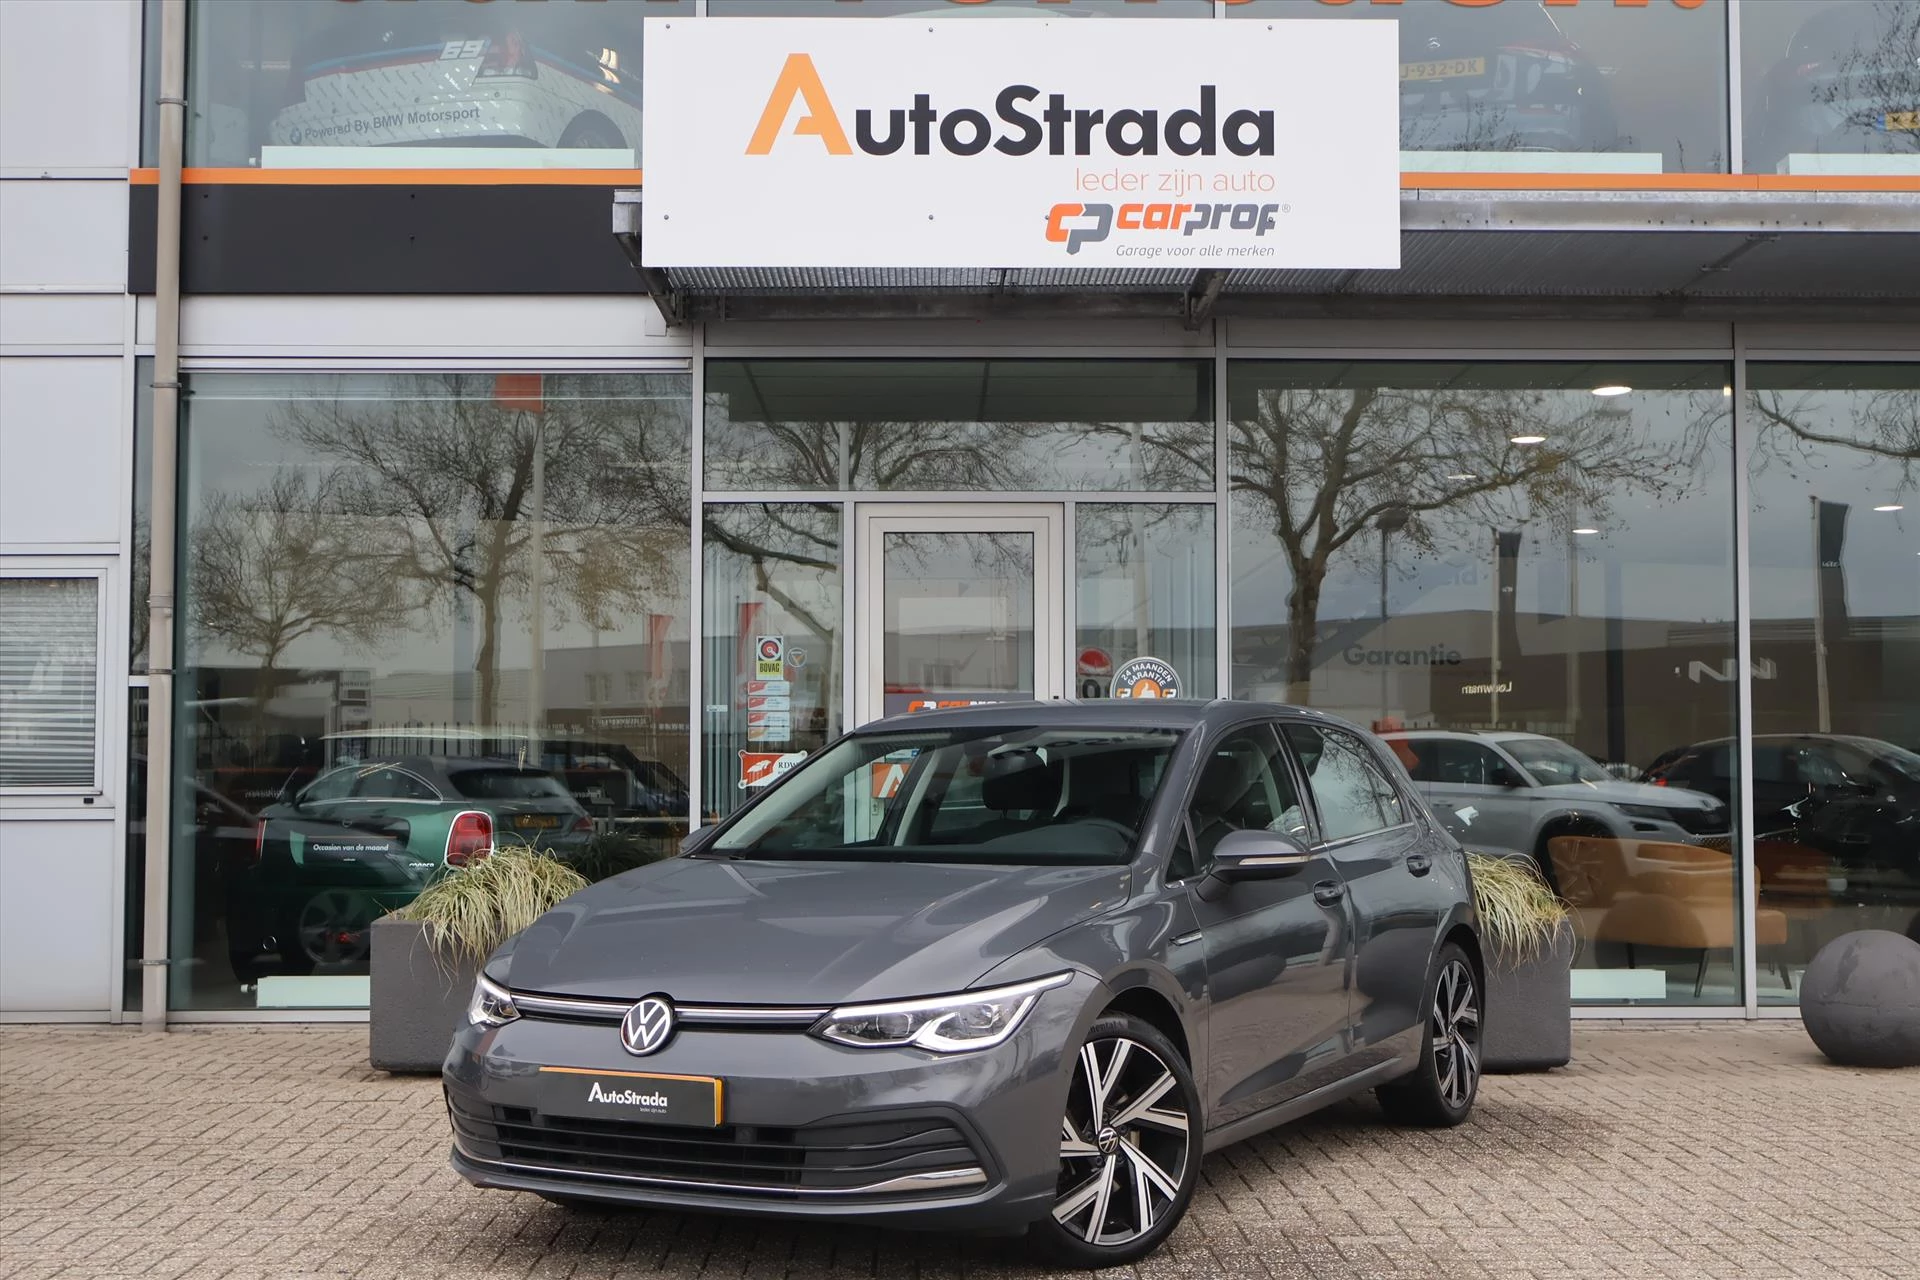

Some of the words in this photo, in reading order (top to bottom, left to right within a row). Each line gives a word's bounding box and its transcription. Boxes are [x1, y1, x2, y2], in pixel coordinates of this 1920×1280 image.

[439, 39, 484, 60] 69
[744, 53, 1275, 157] AutoStrada
[305, 123, 351, 139] Powered
[354, 119, 369, 135] By
[372, 113, 405, 129] BMW
[407, 106, 481, 125] Motorsport
[1075, 168, 1149, 192] Ieder
[1158, 169, 1208, 197] zijn
[1213, 170, 1275, 192] auto
[1116, 244, 1162, 258] Garage
[1166, 246, 1197, 257] voor
[1199, 244, 1223, 257] alle
[1225, 244, 1275, 257] merken
[1343, 643, 1462, 666] Garantie
[759, 662, 780, 674] BOVAG
[1121, 670, 1133, 681] 24
[1131, 662, 1173, 683] MAANDEN
[1127, 670, 1167, 687] GARANTIE
[313, 843, 342, 852] Occasion
[342, 844, 355, 852] van
[355, 843, 364, 852] de
[365, 843, 389, 852] maand
[588, 1082, 668, 1107] AutoStrada
